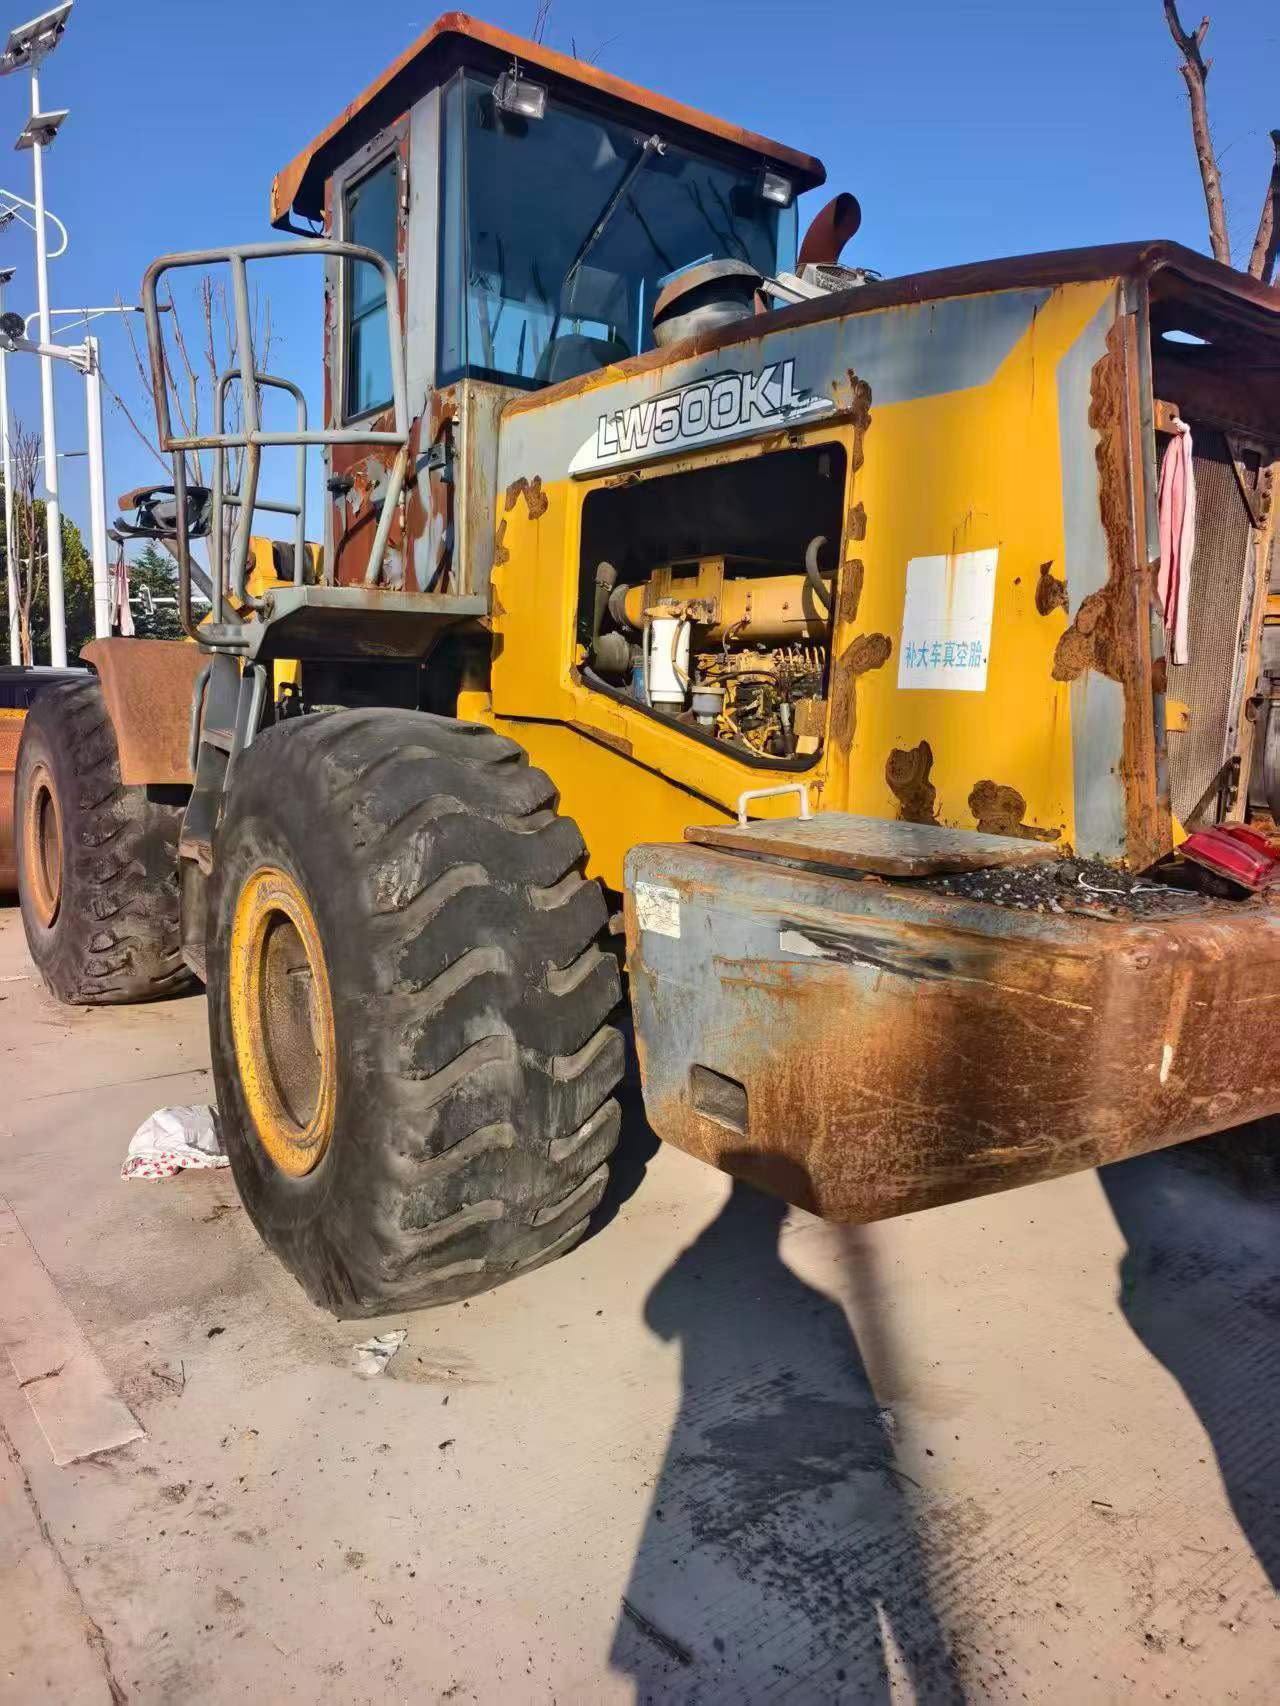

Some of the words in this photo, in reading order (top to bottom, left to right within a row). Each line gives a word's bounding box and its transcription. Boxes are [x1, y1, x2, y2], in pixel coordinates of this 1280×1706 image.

[597, 358, 807, 458] LW500KL
[905, 640, 982, 669] 补大车真空胎
